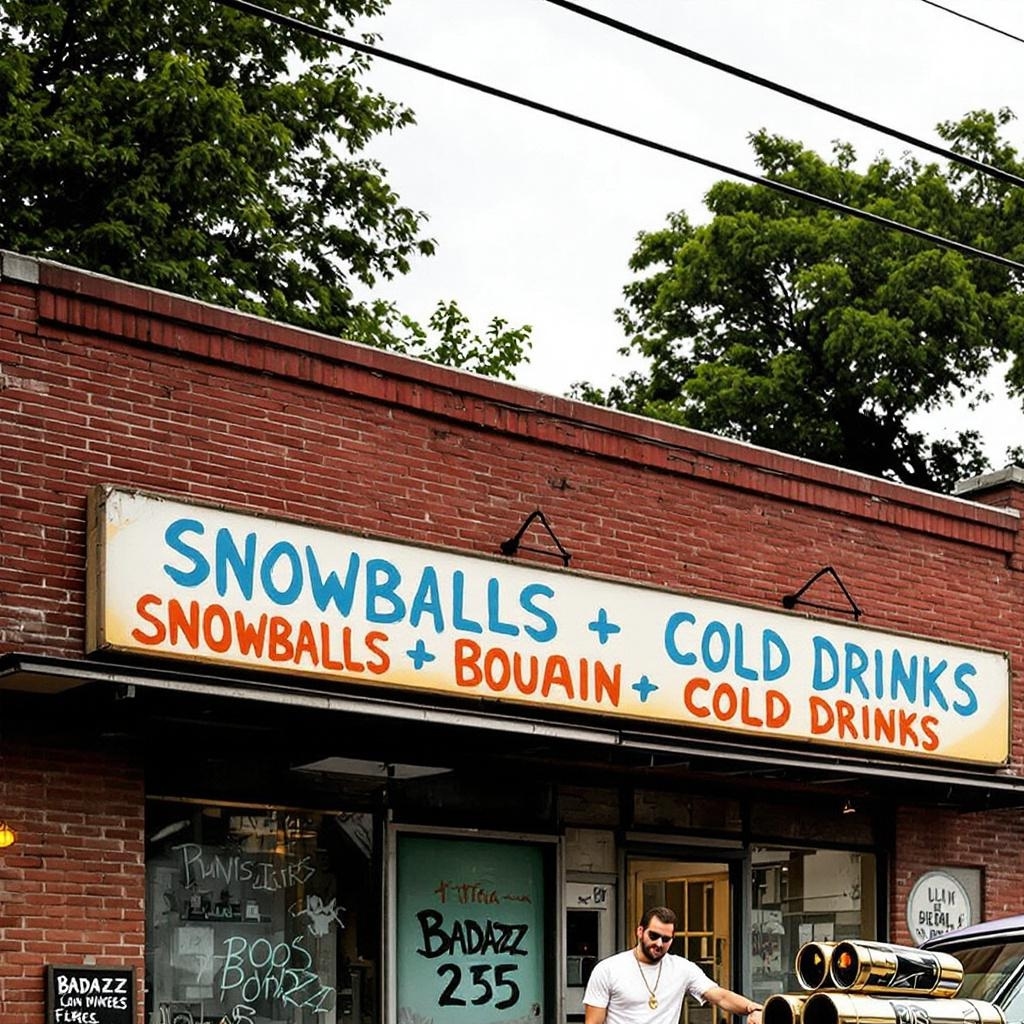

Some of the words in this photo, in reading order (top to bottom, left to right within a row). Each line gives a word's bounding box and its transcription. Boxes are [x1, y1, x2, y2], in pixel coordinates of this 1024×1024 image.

[163, 518, 558, 643] SNOWBALLS
[664, 611, 791, 682] COLD
[812, 635, 978, 717] DRINKS
[131, 593, 390, 675] SNOWBALLS
[454, 638, 622, 708] BOUAIN
[684, 677, 791, 729] COLD
[811, 696, 940, 752] DRINKS
[57, 975, 128, 994] BADAZZ
[416, 909, 528, 959] BADAZZ
